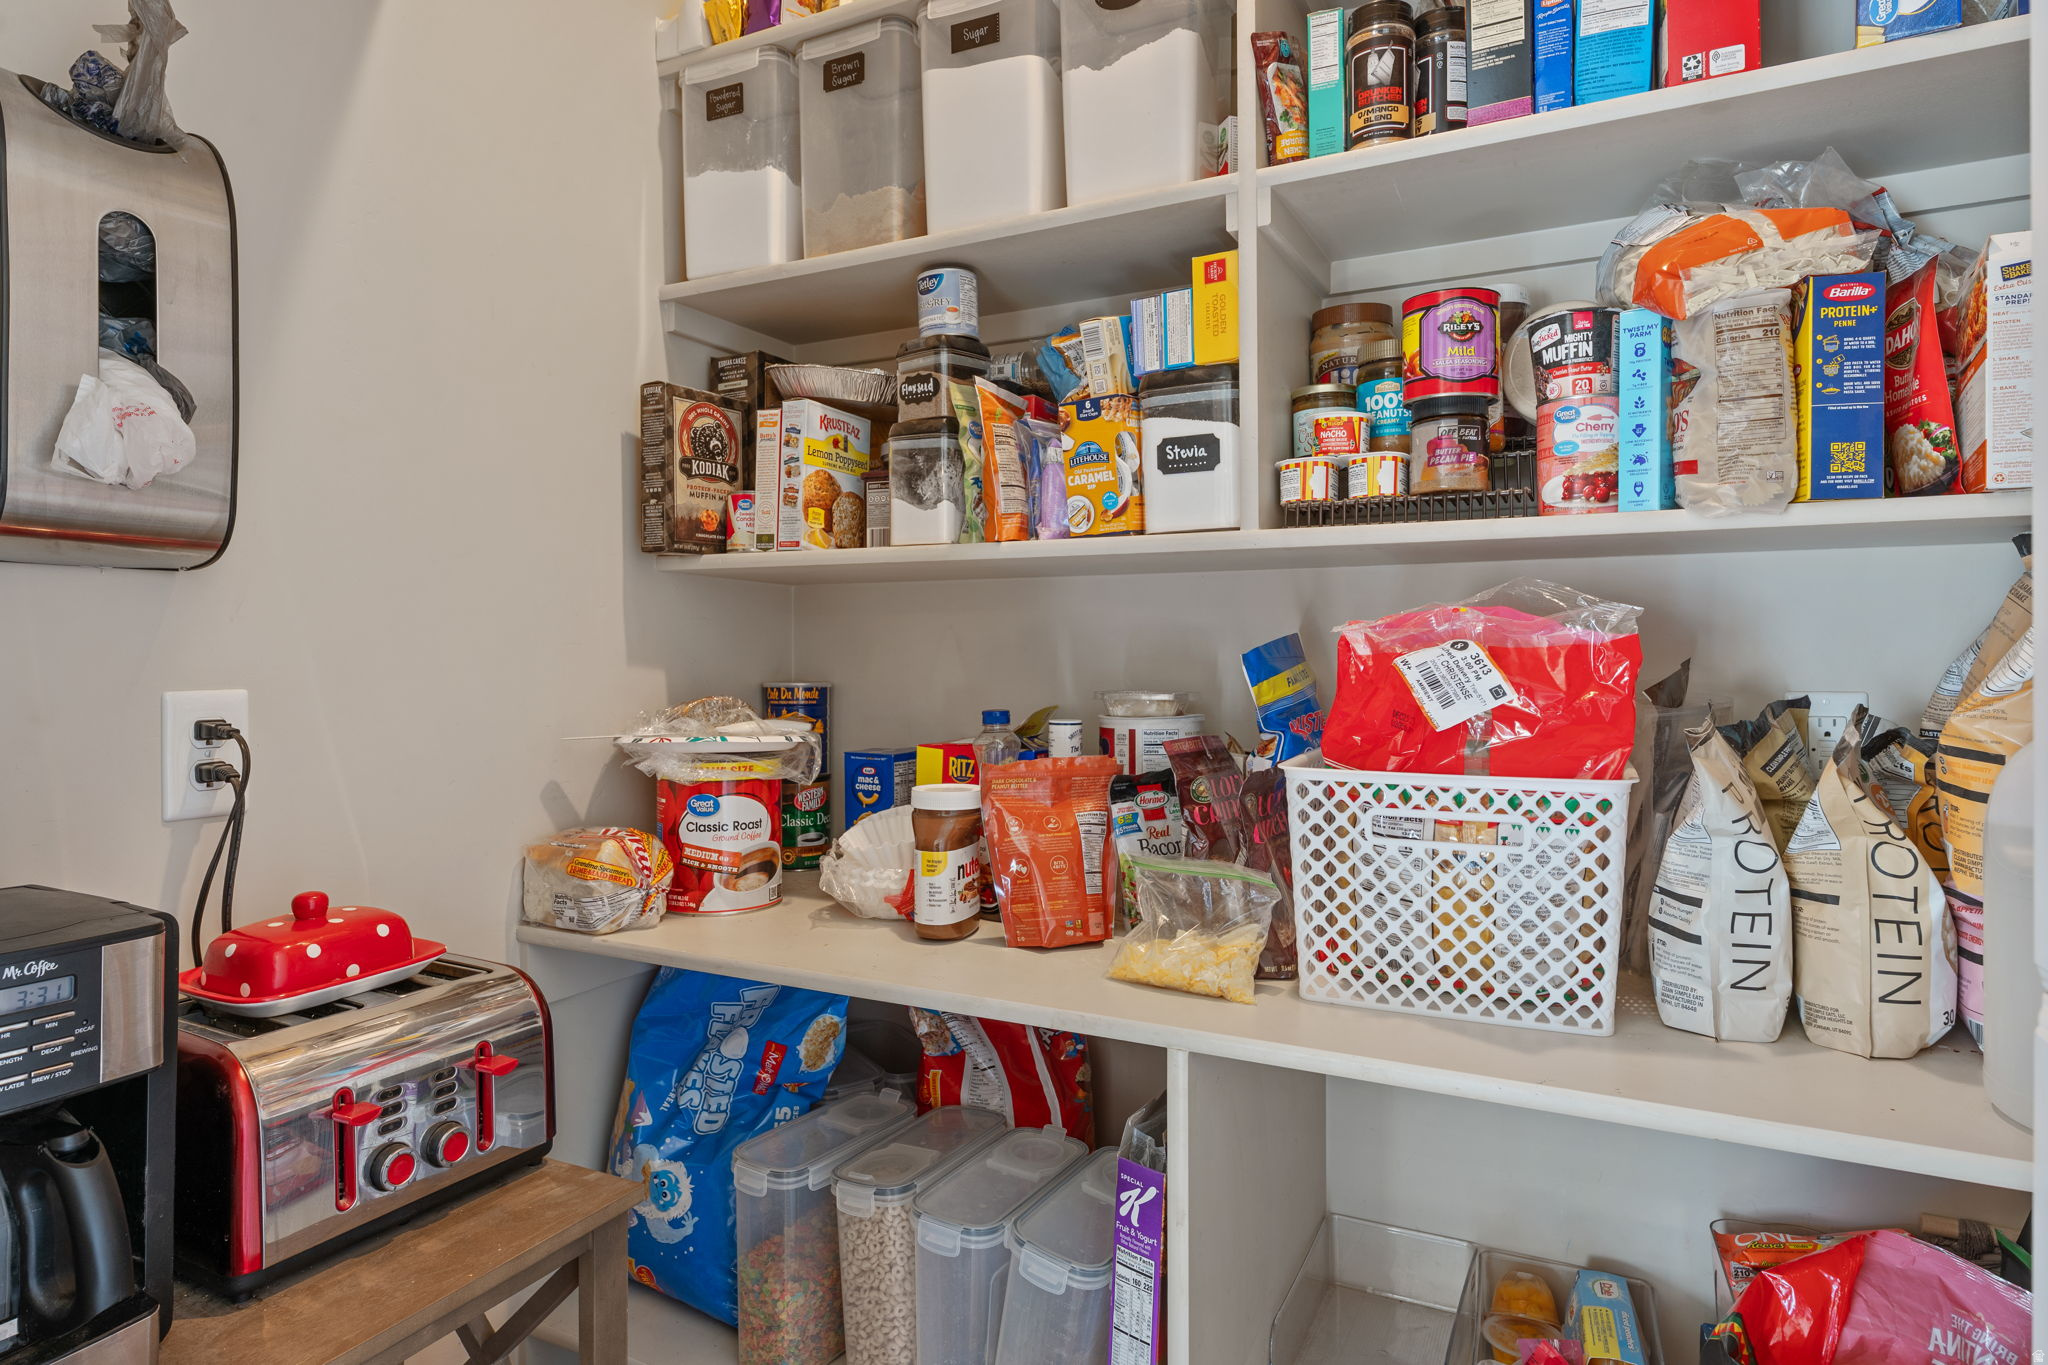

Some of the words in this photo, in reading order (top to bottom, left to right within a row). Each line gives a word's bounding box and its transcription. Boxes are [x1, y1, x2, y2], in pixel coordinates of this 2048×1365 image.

[963, 24, 989, 43] Sugar
[832, 59, 860, 73] Brown
[832, 72, 857, 87] Sugar
[709, 86, 741, 103] Powdered
[1358, 86, 1402, 100] DRUNKEN
[715, 100, 736, 113] Sugar
[1358, 94, 1402, 107] BUTCHER
[1364, 113, 1392, 124] BLEND
[919, 277, 939, 291] Tetley
[1829, 286, 1868, 298] Barilla
[1212, 293, 1220, 337] TOASTED
[1714, 309, 1754, 320] Nutrition
[1820, 305, 1878, 318] PROTEIN+
[1622, 326, 1646, 334] TWIST
[1648, 323, 1659, 331] MY
[1629, 331, 1652, 339] PARM
[1564, 332, 1593, 343] MIGHTY
[1716, 334, 1751, 344] Calories
[1762, 328, 1780, 337] 210
[1447, 346, 1475, 357] Mild
[1542, 341, 1593, 365] MUFFIN
[1321, 356, 1357, 370] NATUR
[1085, 400, 1090, 408] 6
[1556, 409, 1575, 417] Great
[819, 414, 860, 440] KRUSTEAZ
[1441, 429, 1457, 437] OFF
[1459, 428, 1478, 436] BEAT
[1576, 422, 1614, 432] Cherry
[1320, 430, 1347, 439] NACHO
[807, 445, 833, 461] Lemon
[835, 452, 868, 471] Poppyseed
[1166, 445, 1207, 460] Stevia
[1435, 447, 1461, 456] BUTTER
[1070, 453, 1109, 467] LITEHOUSE
[1429, 455, 1457, 466] PECAN
[1460, 454, 1475, 462] PIE
[692, 459, 730, 481] KODIAK
[1068, 473, 1115, 487] CARAMEL
[689, 491, 716, 500] MUFFIN
[1470, 653, 1492, 676] 3613
[1452, 660, 1472, 684] Delivery
[1441, 660, 1473, 700] CHRISTENSE
[780, 688, 792, 699] Du
[949, 756, 975, 778] RITZ
[855, 783, 881, 791] cheese
[690, 799, 714, 808] Great
[801, 797, 821, 811] FAMILY
[1139, 796, 1166, 805] Hormel
[686, 822, 729, 833] Classic
[733, 818, 762, 832] Roast
[781, 815, 814, 827] Classic
[1118, 816, 1124, 824] 6
[712, 833, 739, 842] Ground
[741, 832, 762, 842] Coffee
[1146, 825, 1170, 839] Real
[684, 847, 719, 861] MEDIUM
[574, 860, 599, 870] Grandma
[682, 858, 699, 868] RICH
[707, 864, 739, 873] SMOOTH
[958, 857, 980, 880] nute
[608, 874, 633, 887] BREAD
[24, 960, 58, 978] Coffee
[1662, 979, 1689, 992] DISTRIBUTED
[1662, 985, 1673, 994] CLEAN
[1674, 989, 1691, 999] SIMPLE
[15, 984, 62, 1009] 3:31
[1661, 993, 1697, 1007] MANUFACTURED
[1943, 1009, 1954, 1026] 30
[75, 1025, 95, 1035] DECAF
[41, 1046, 63, 1056] DECAF
[70, 1045, 98, 1057] BREWING
[31, 1073, 50, 1084] BREW
[55, 1069, 72, 1078] STOP
[4, 1082, 25, 1091] LATER
[1120, 1173, 1144, 1188] SPECIAL
[1119, 1186, 1157, 1228] K
[1116, 1220, 1129, 1233] Fruit
[1130, 1227, 1136, 1235] &
[1136, 1229, 1158, 1247] Yogurt
[1117, 1246, 1139, 1261] Nutrition
[1139, 1255, 1154, 1268] Facts
[1734, 1269, 1751, 1277] 210
[1132, 1276, 1141, 1288] 160
[1143, 1282, 1153, 1293] 220
